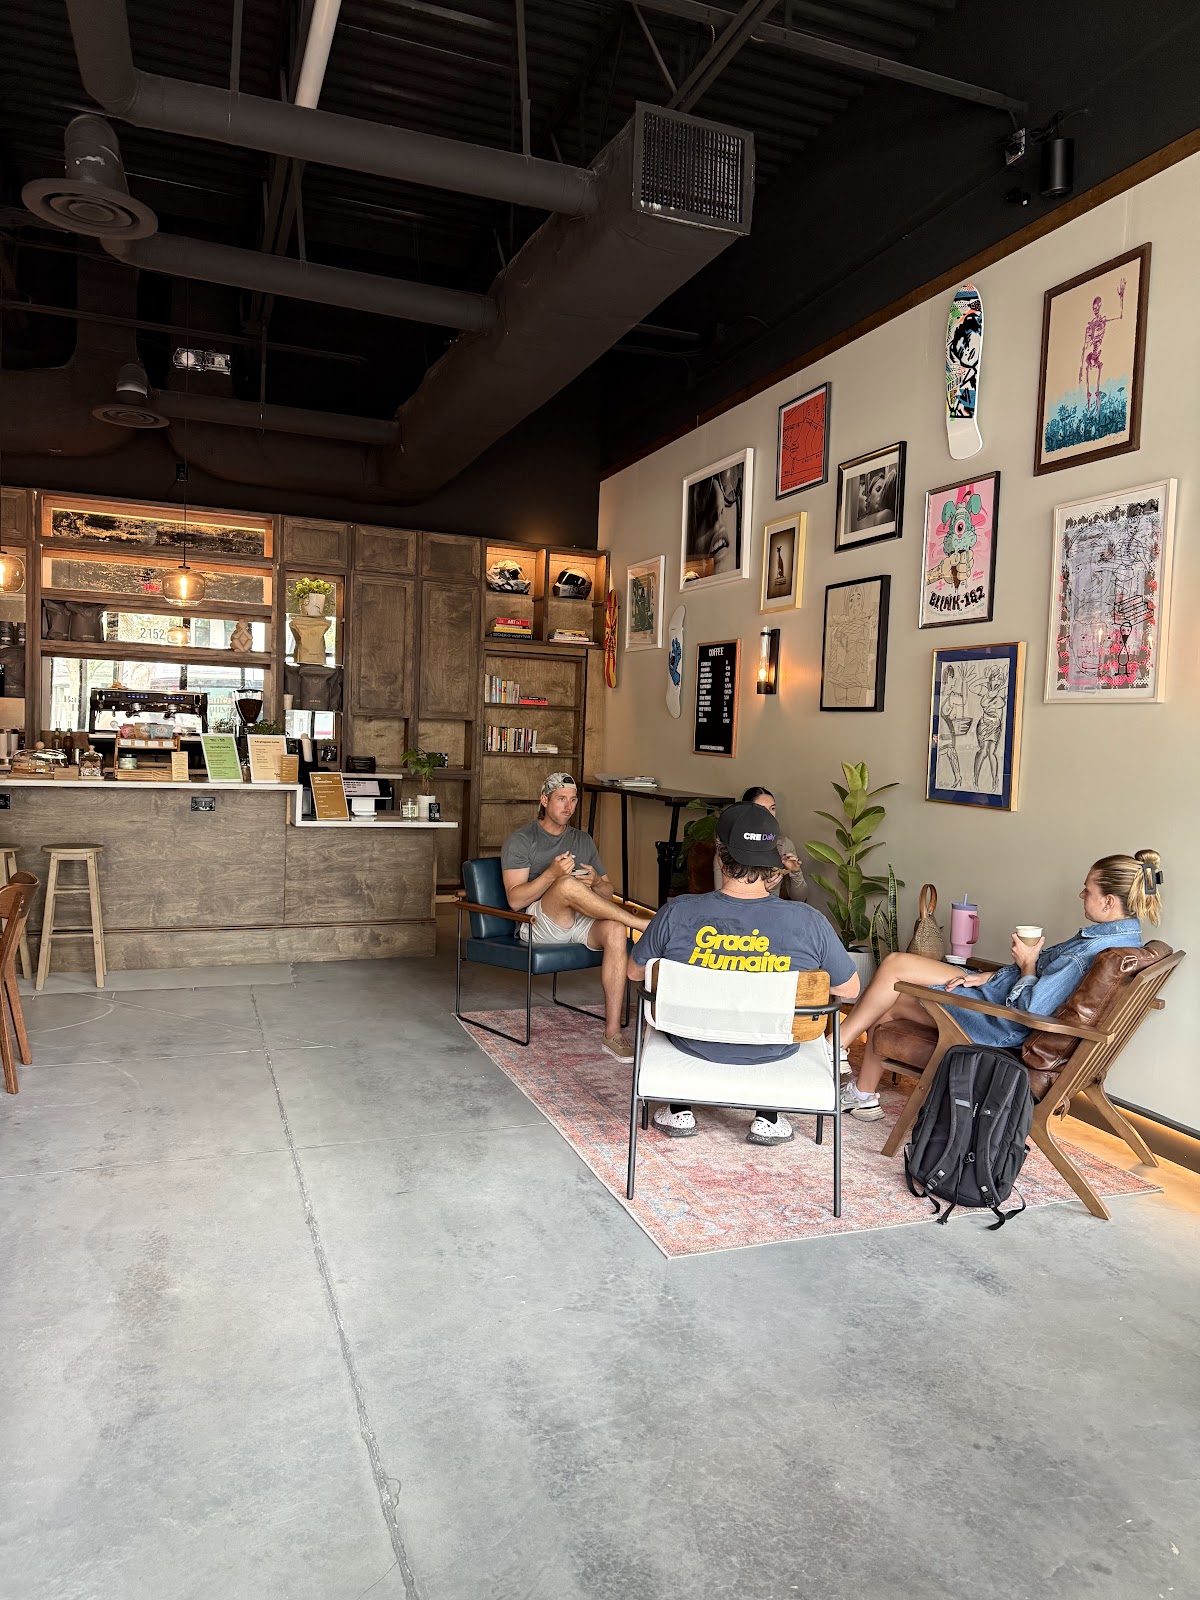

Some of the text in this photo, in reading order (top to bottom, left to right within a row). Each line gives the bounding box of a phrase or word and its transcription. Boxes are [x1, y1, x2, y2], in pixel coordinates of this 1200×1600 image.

[929, 585, 985, 611] BLINK-182
[140, 627, 165, 640] 2152
[708, 647, 724, 657] COFFEE
[743, 832, 761, 841] CRE
[696, 926, 769, 952] Gracie
[688, 946, 791, 972] Humaita
